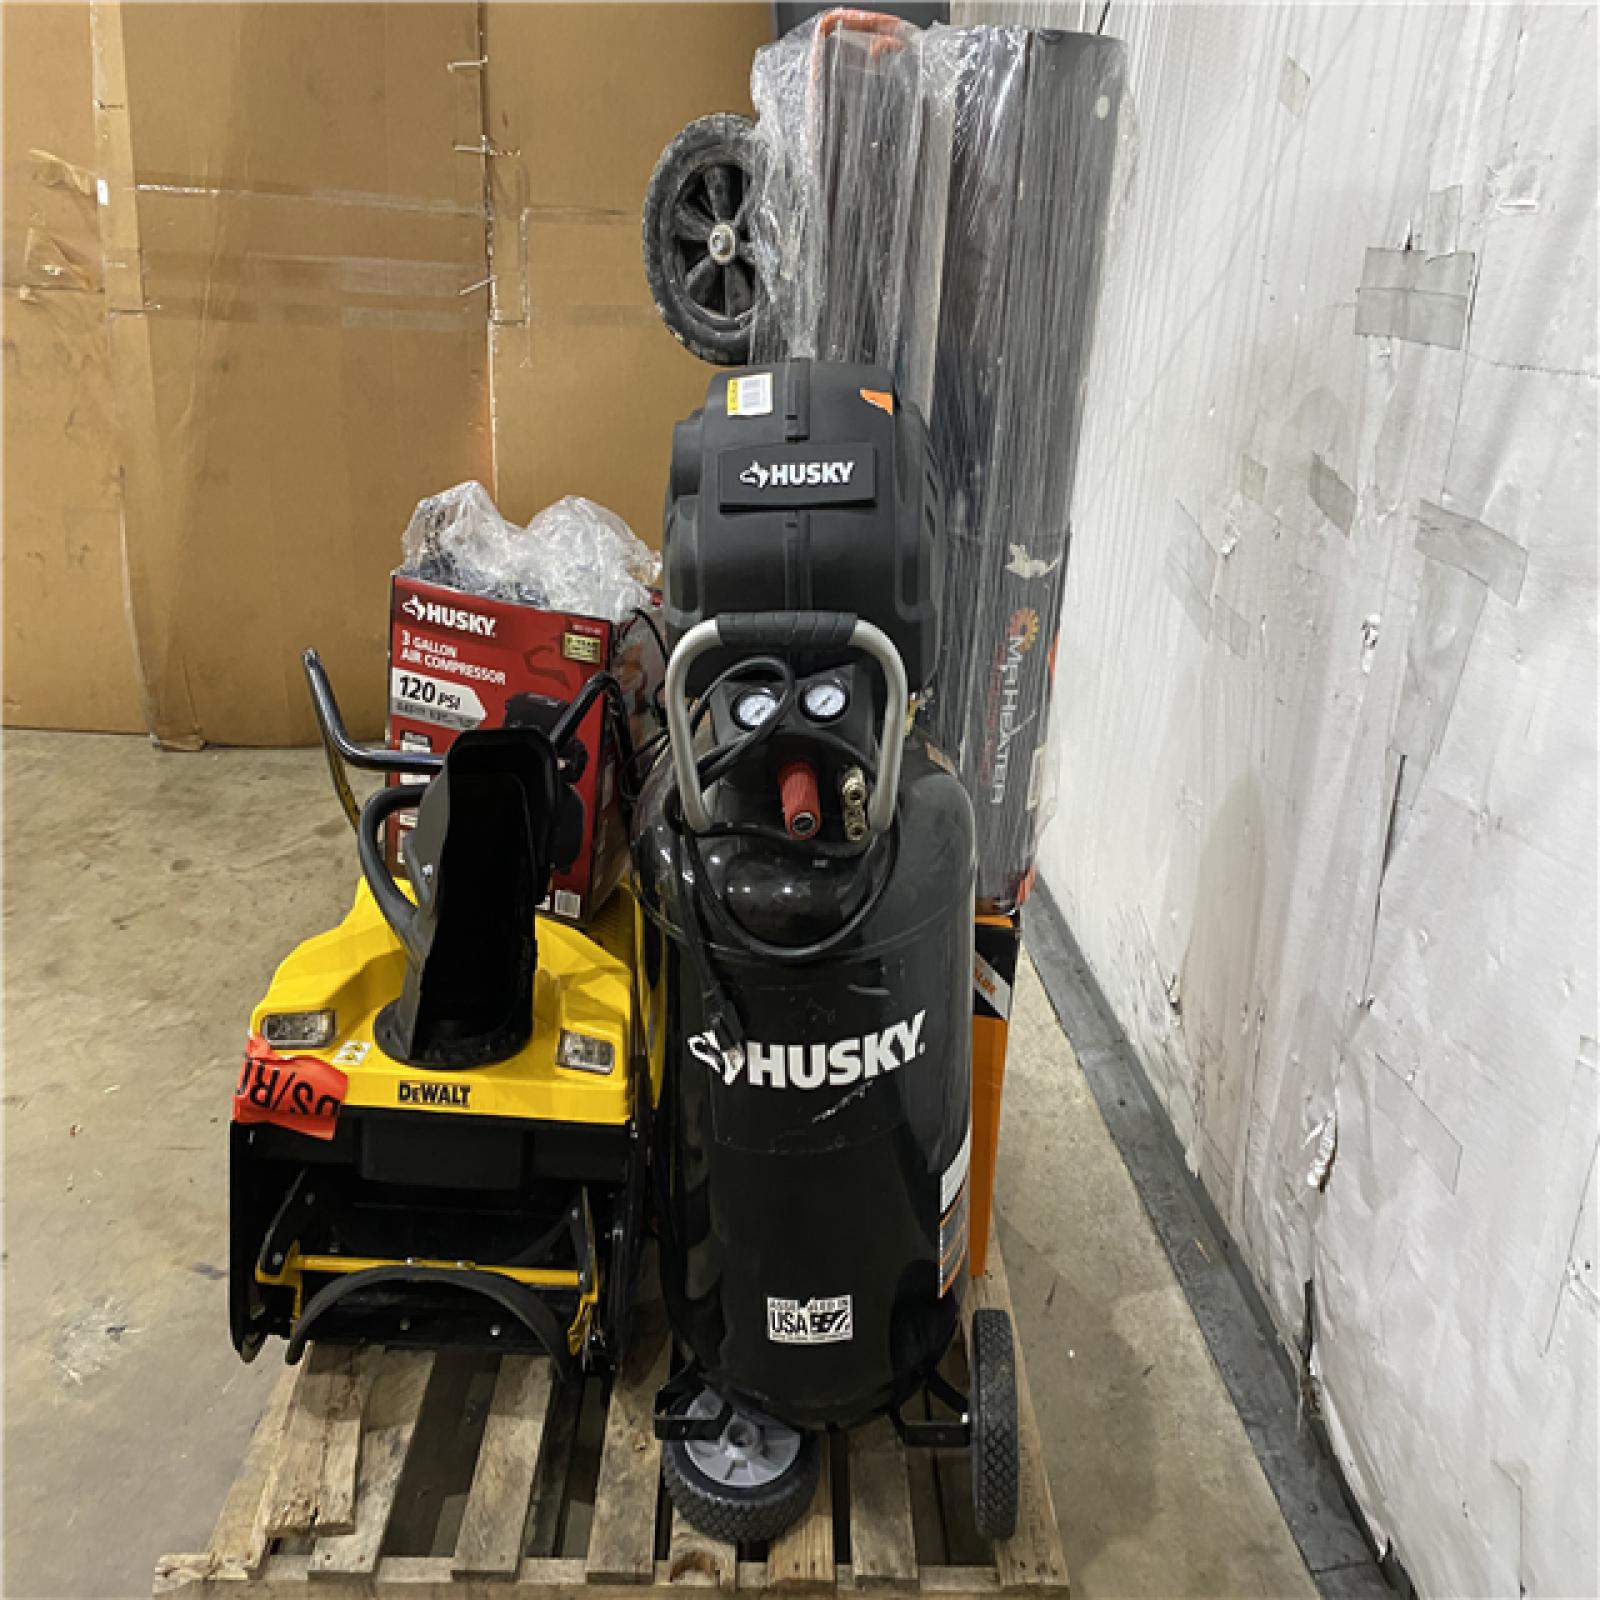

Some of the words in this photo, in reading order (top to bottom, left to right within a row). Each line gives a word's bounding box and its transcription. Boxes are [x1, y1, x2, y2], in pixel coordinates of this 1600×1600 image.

[770, 461, 854, 485] HUSKY
[426, 602, 496, 636] HUSKY
[413, 637, 457, 658] GALLON
[401, 648, 421, 662] AIR
[424, 654, 505, 685] COMPRESSOR
[400, 675, 435, 702] 120
[438, 692, 460, 709] PSI
[746, 1009, 926, 1088] HUSKY
